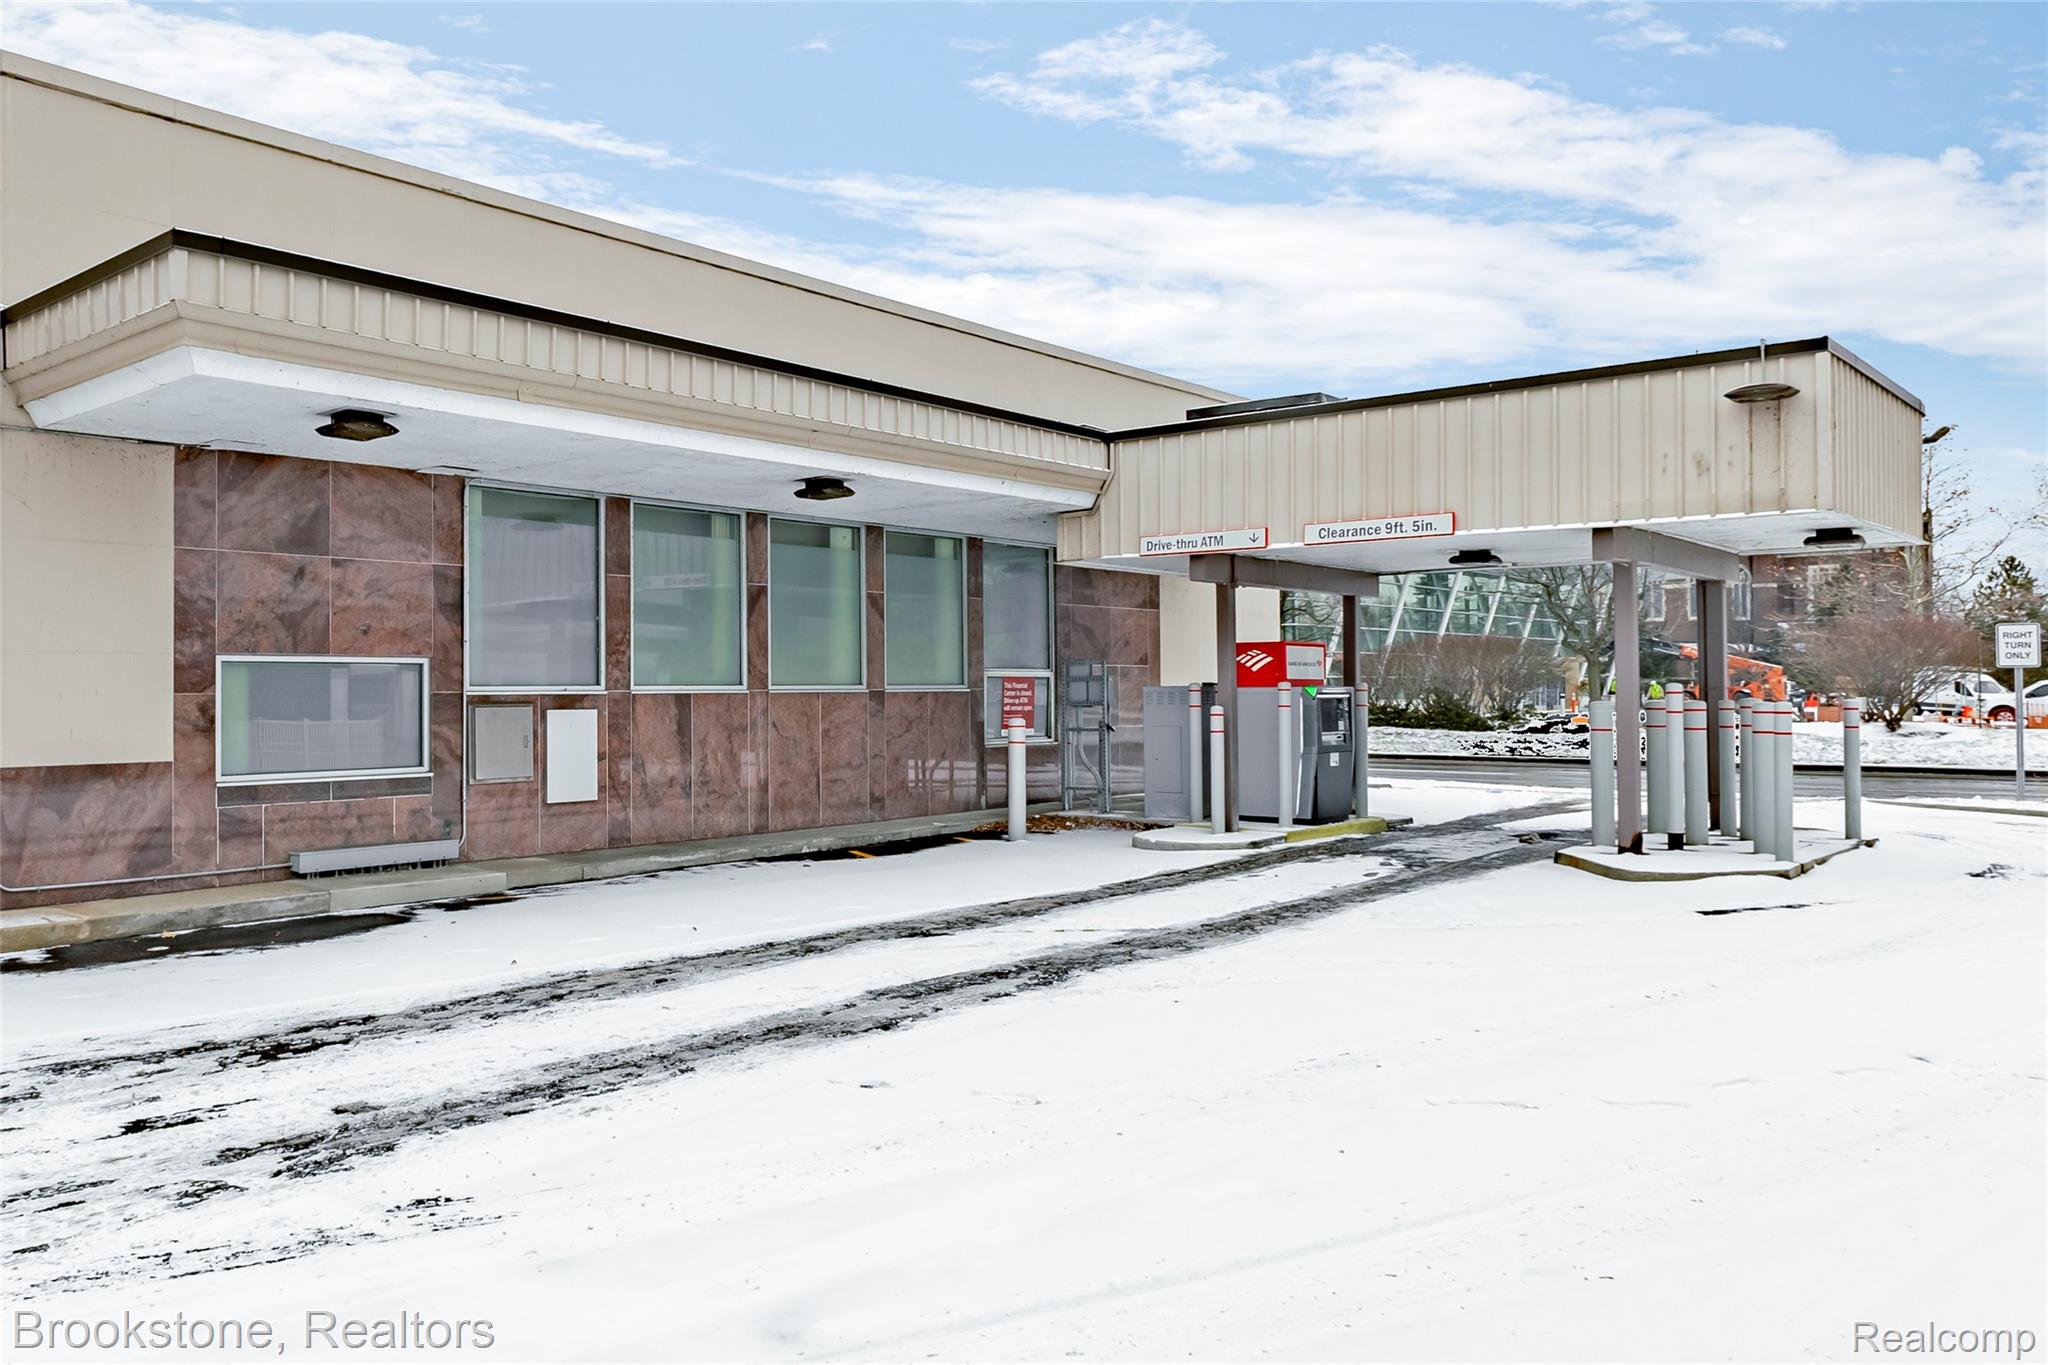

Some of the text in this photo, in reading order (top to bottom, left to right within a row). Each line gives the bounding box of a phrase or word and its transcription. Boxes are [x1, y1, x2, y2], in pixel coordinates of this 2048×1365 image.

[1318, 519, 1438, 539] Clearance 9ft. 5in.
[1146, 535, 1224, 552] Drive-thru ATM
[2002, 631, 2033, 639] RIGHT
[2004, 641, 2032, 649] TURN
[2004, 651, 2031, 660] ONLY
